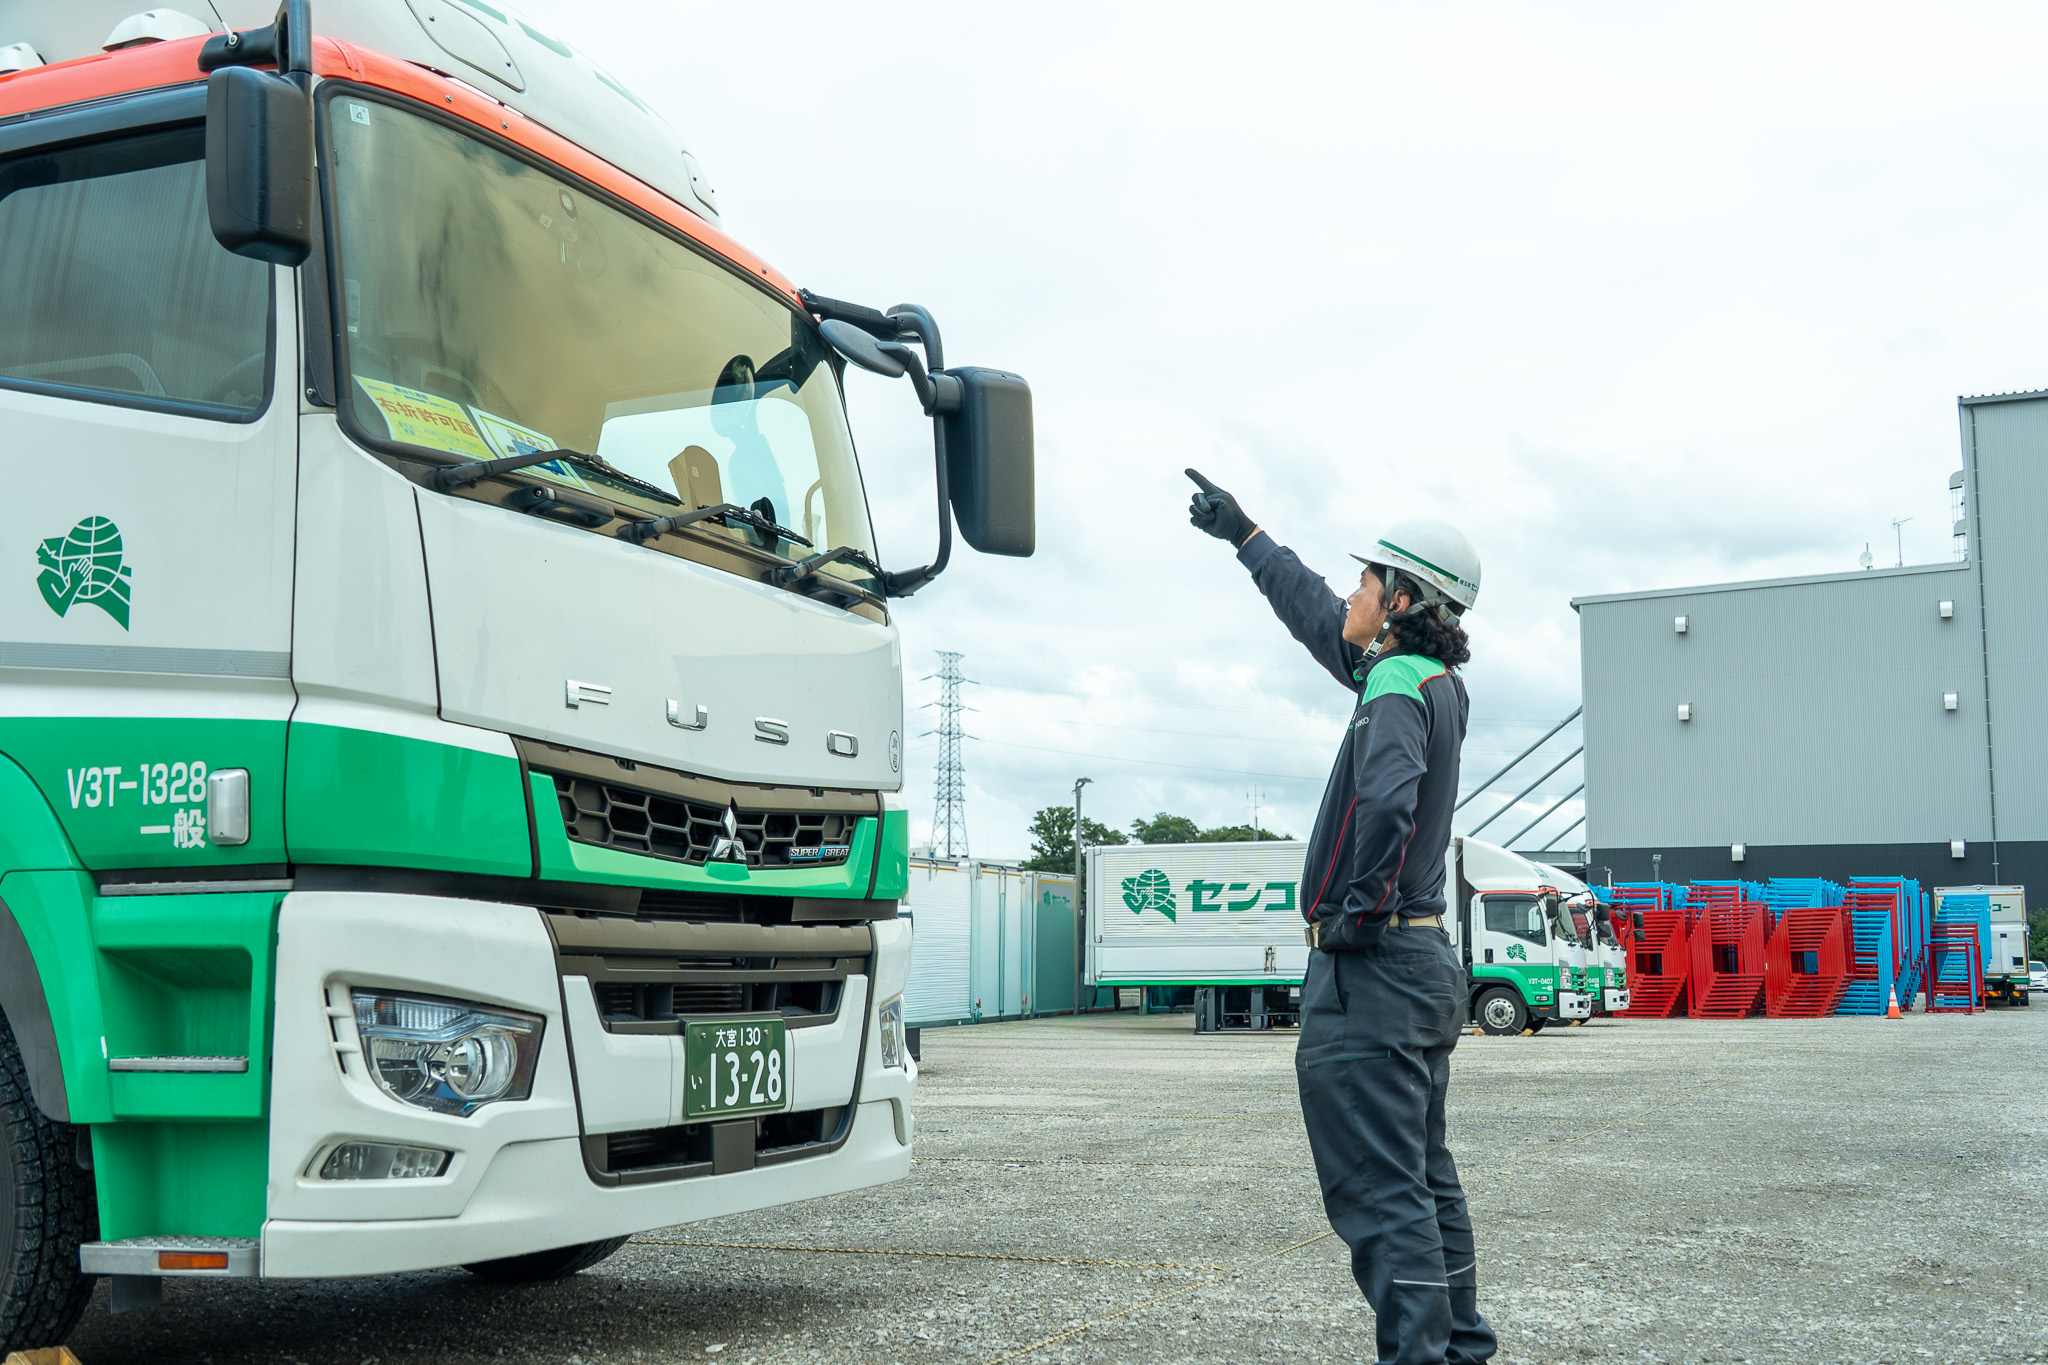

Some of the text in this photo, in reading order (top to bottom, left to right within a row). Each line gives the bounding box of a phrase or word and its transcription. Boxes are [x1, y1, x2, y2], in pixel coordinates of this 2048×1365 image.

[375, 397, 480, 439] 右折許可証
[565, 679, 858, 759] FUSO
[1355, 716, 1370, 730] NKO
[67, 761, 207, 809] V3T-1328
[140, 808, 206, 848] 一般
[790, 848, 850, 857] SUPER GREAT
[1185, 879, 1299, 912] センコ
[1991, 903, 2011, 912] コー
[691, 1048, 782, 1108] い 13-28
